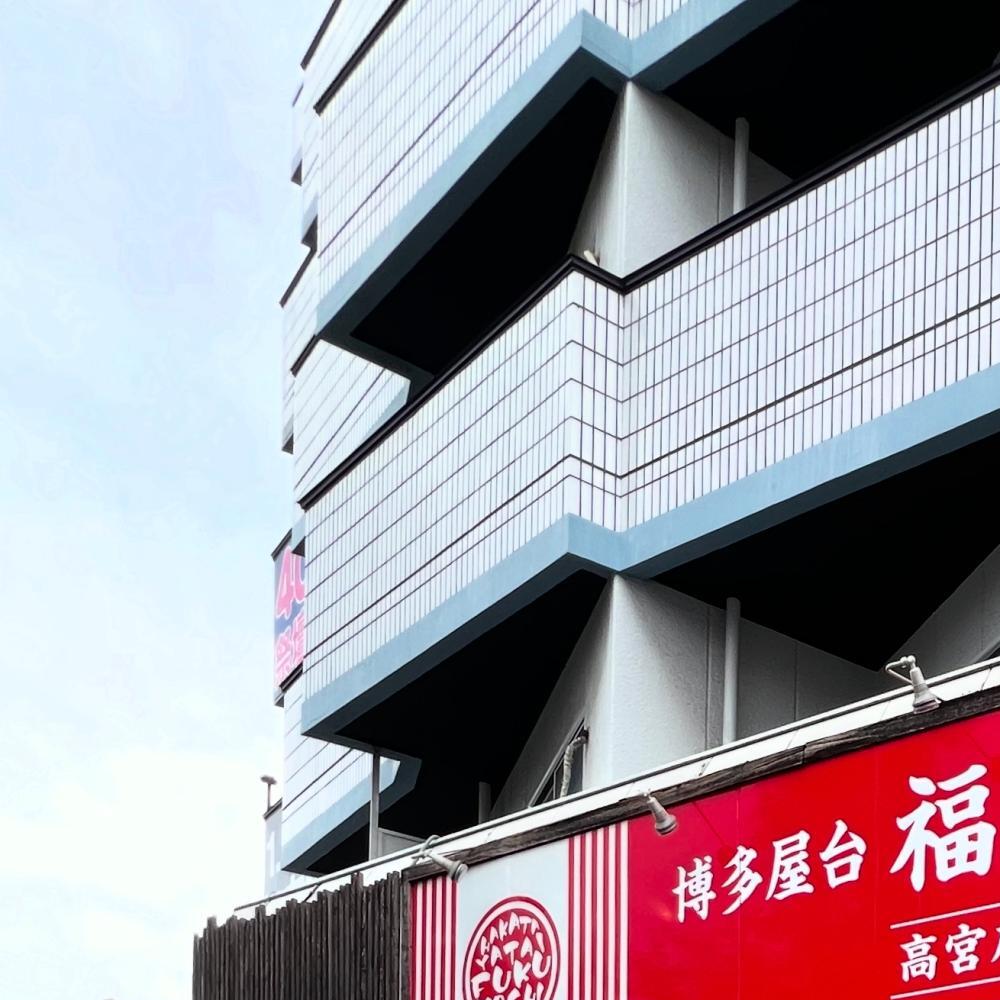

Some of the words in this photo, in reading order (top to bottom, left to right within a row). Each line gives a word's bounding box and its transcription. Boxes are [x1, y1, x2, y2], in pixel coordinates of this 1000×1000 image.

[671, 819, 867, 924] 博多屋台
[475, 932, 545, 971] YATAI
[480, 911, 541, 955] HAKATA
[470, 950, 552, 999] FUKU
